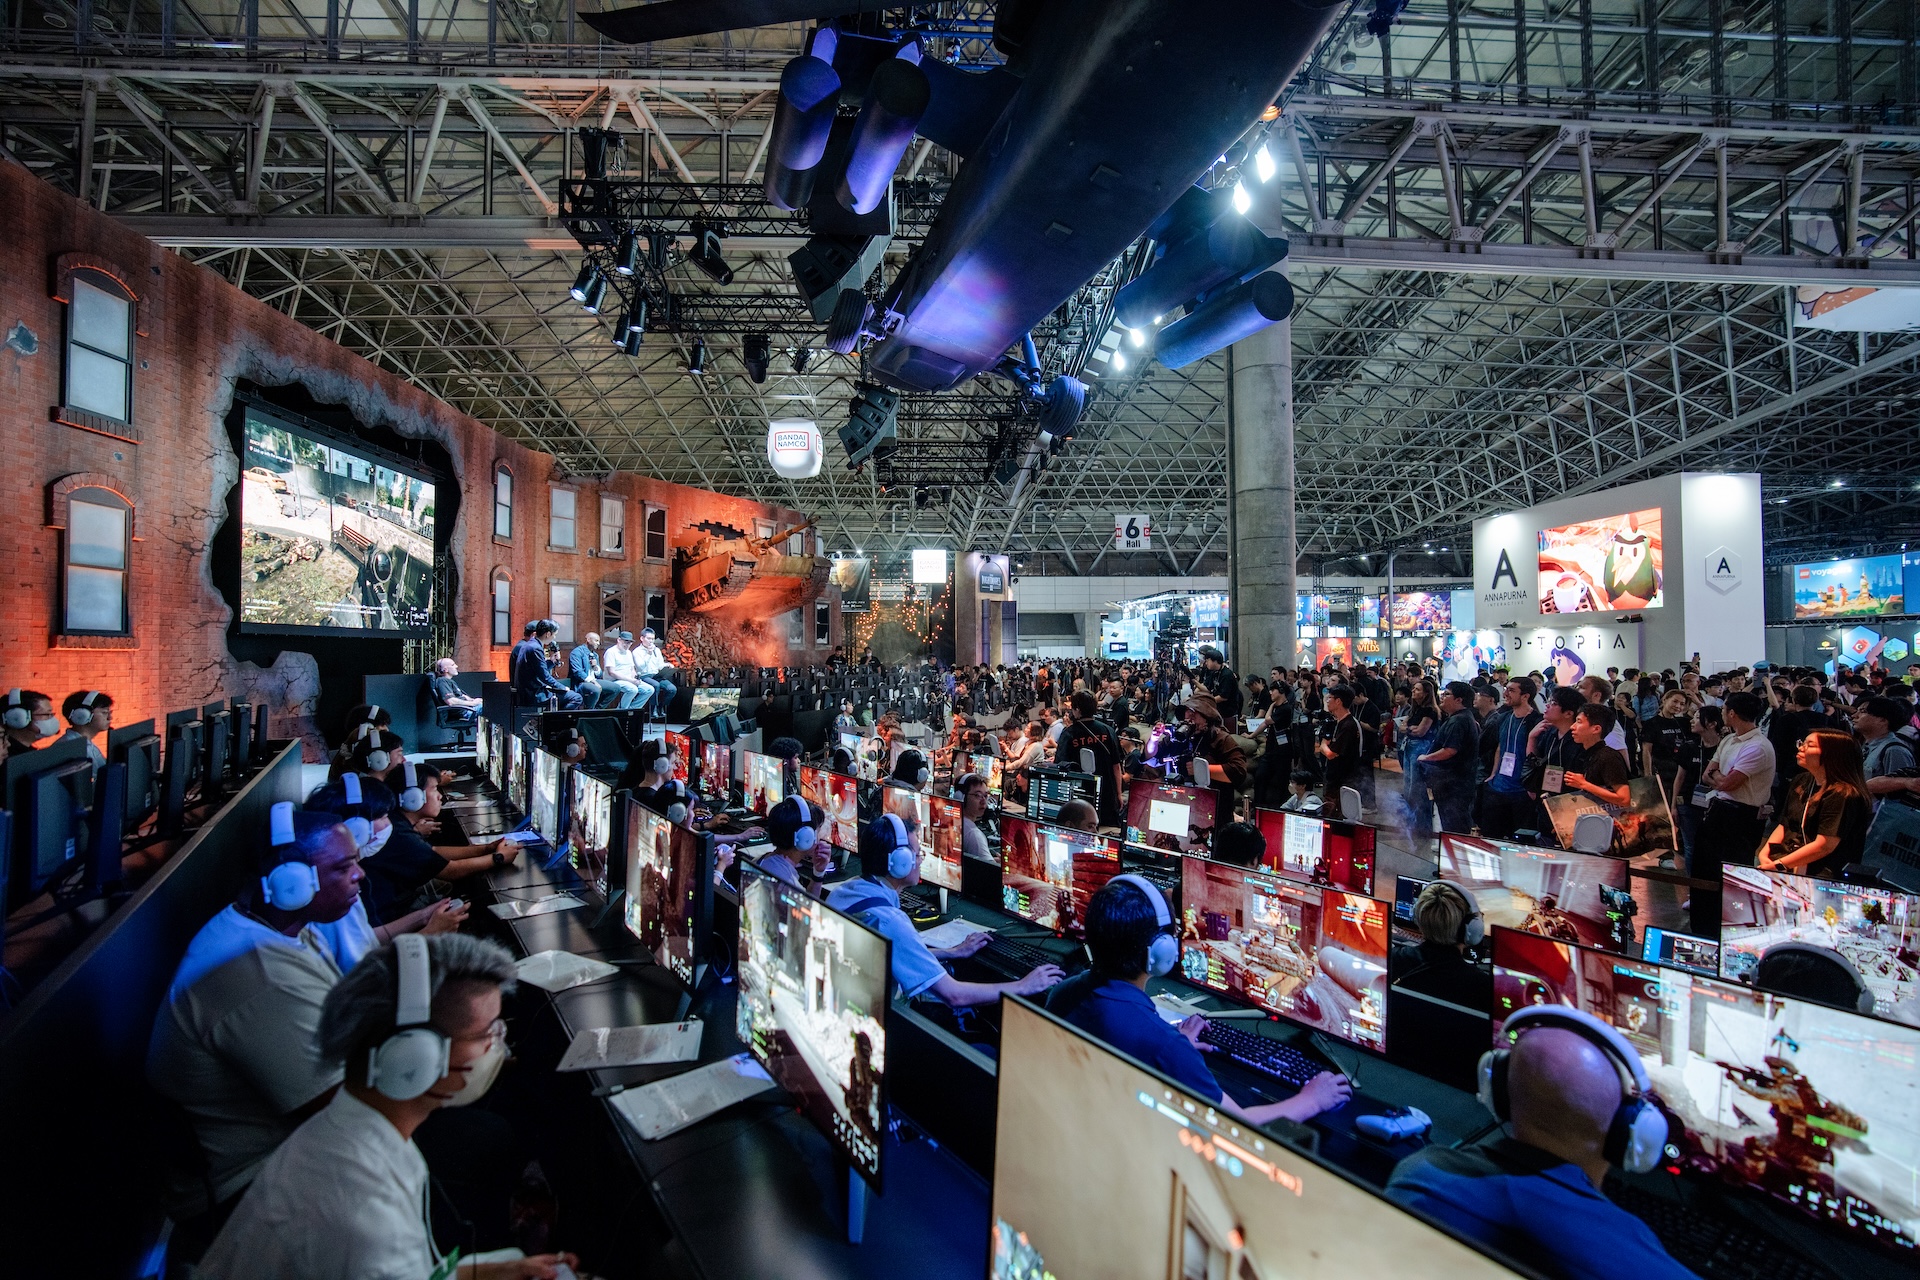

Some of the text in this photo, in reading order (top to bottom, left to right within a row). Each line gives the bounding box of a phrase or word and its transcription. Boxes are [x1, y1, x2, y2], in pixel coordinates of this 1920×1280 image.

[1126, 518, 1140, 538] 6
[1126, 540, 1141, 548] Hall
[1491, 548, 1518, 590] A
[1717, 557, 1731, 573] A
[1484, 590, 1528, 603] ANNAPURNA
[1199, 612, 1219, 623] THAILAND
[1356, 644, 1380, 652] WILDS
[1301, 654, 1311, 664] A
[1072, 734, 1108, 747] STAFF
[1575, 802, 1629, 816] BATTLEFIEL
